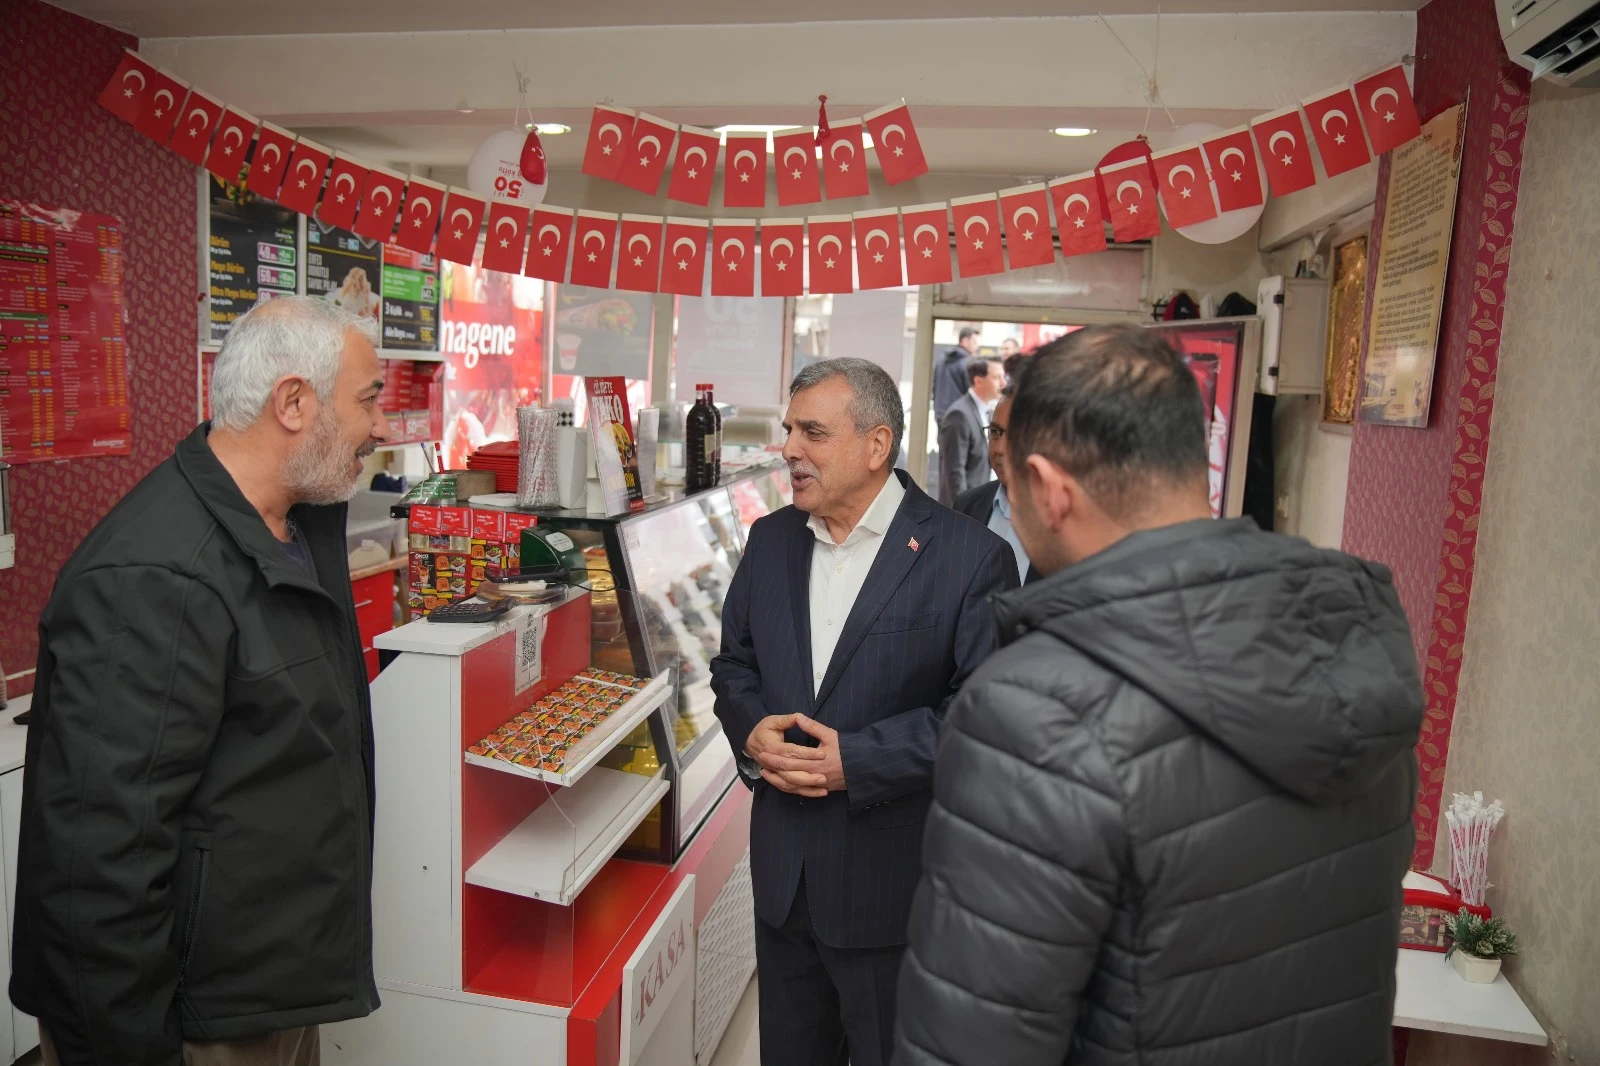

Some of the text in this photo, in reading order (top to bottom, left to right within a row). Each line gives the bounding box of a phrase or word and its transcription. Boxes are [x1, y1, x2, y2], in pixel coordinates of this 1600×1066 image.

[494, 176, 522, 199] 50
[441, 319, 516, 369] magene
[592, 394, 624, 428] TAKO
[638, 919, 687, 1026] KASA
